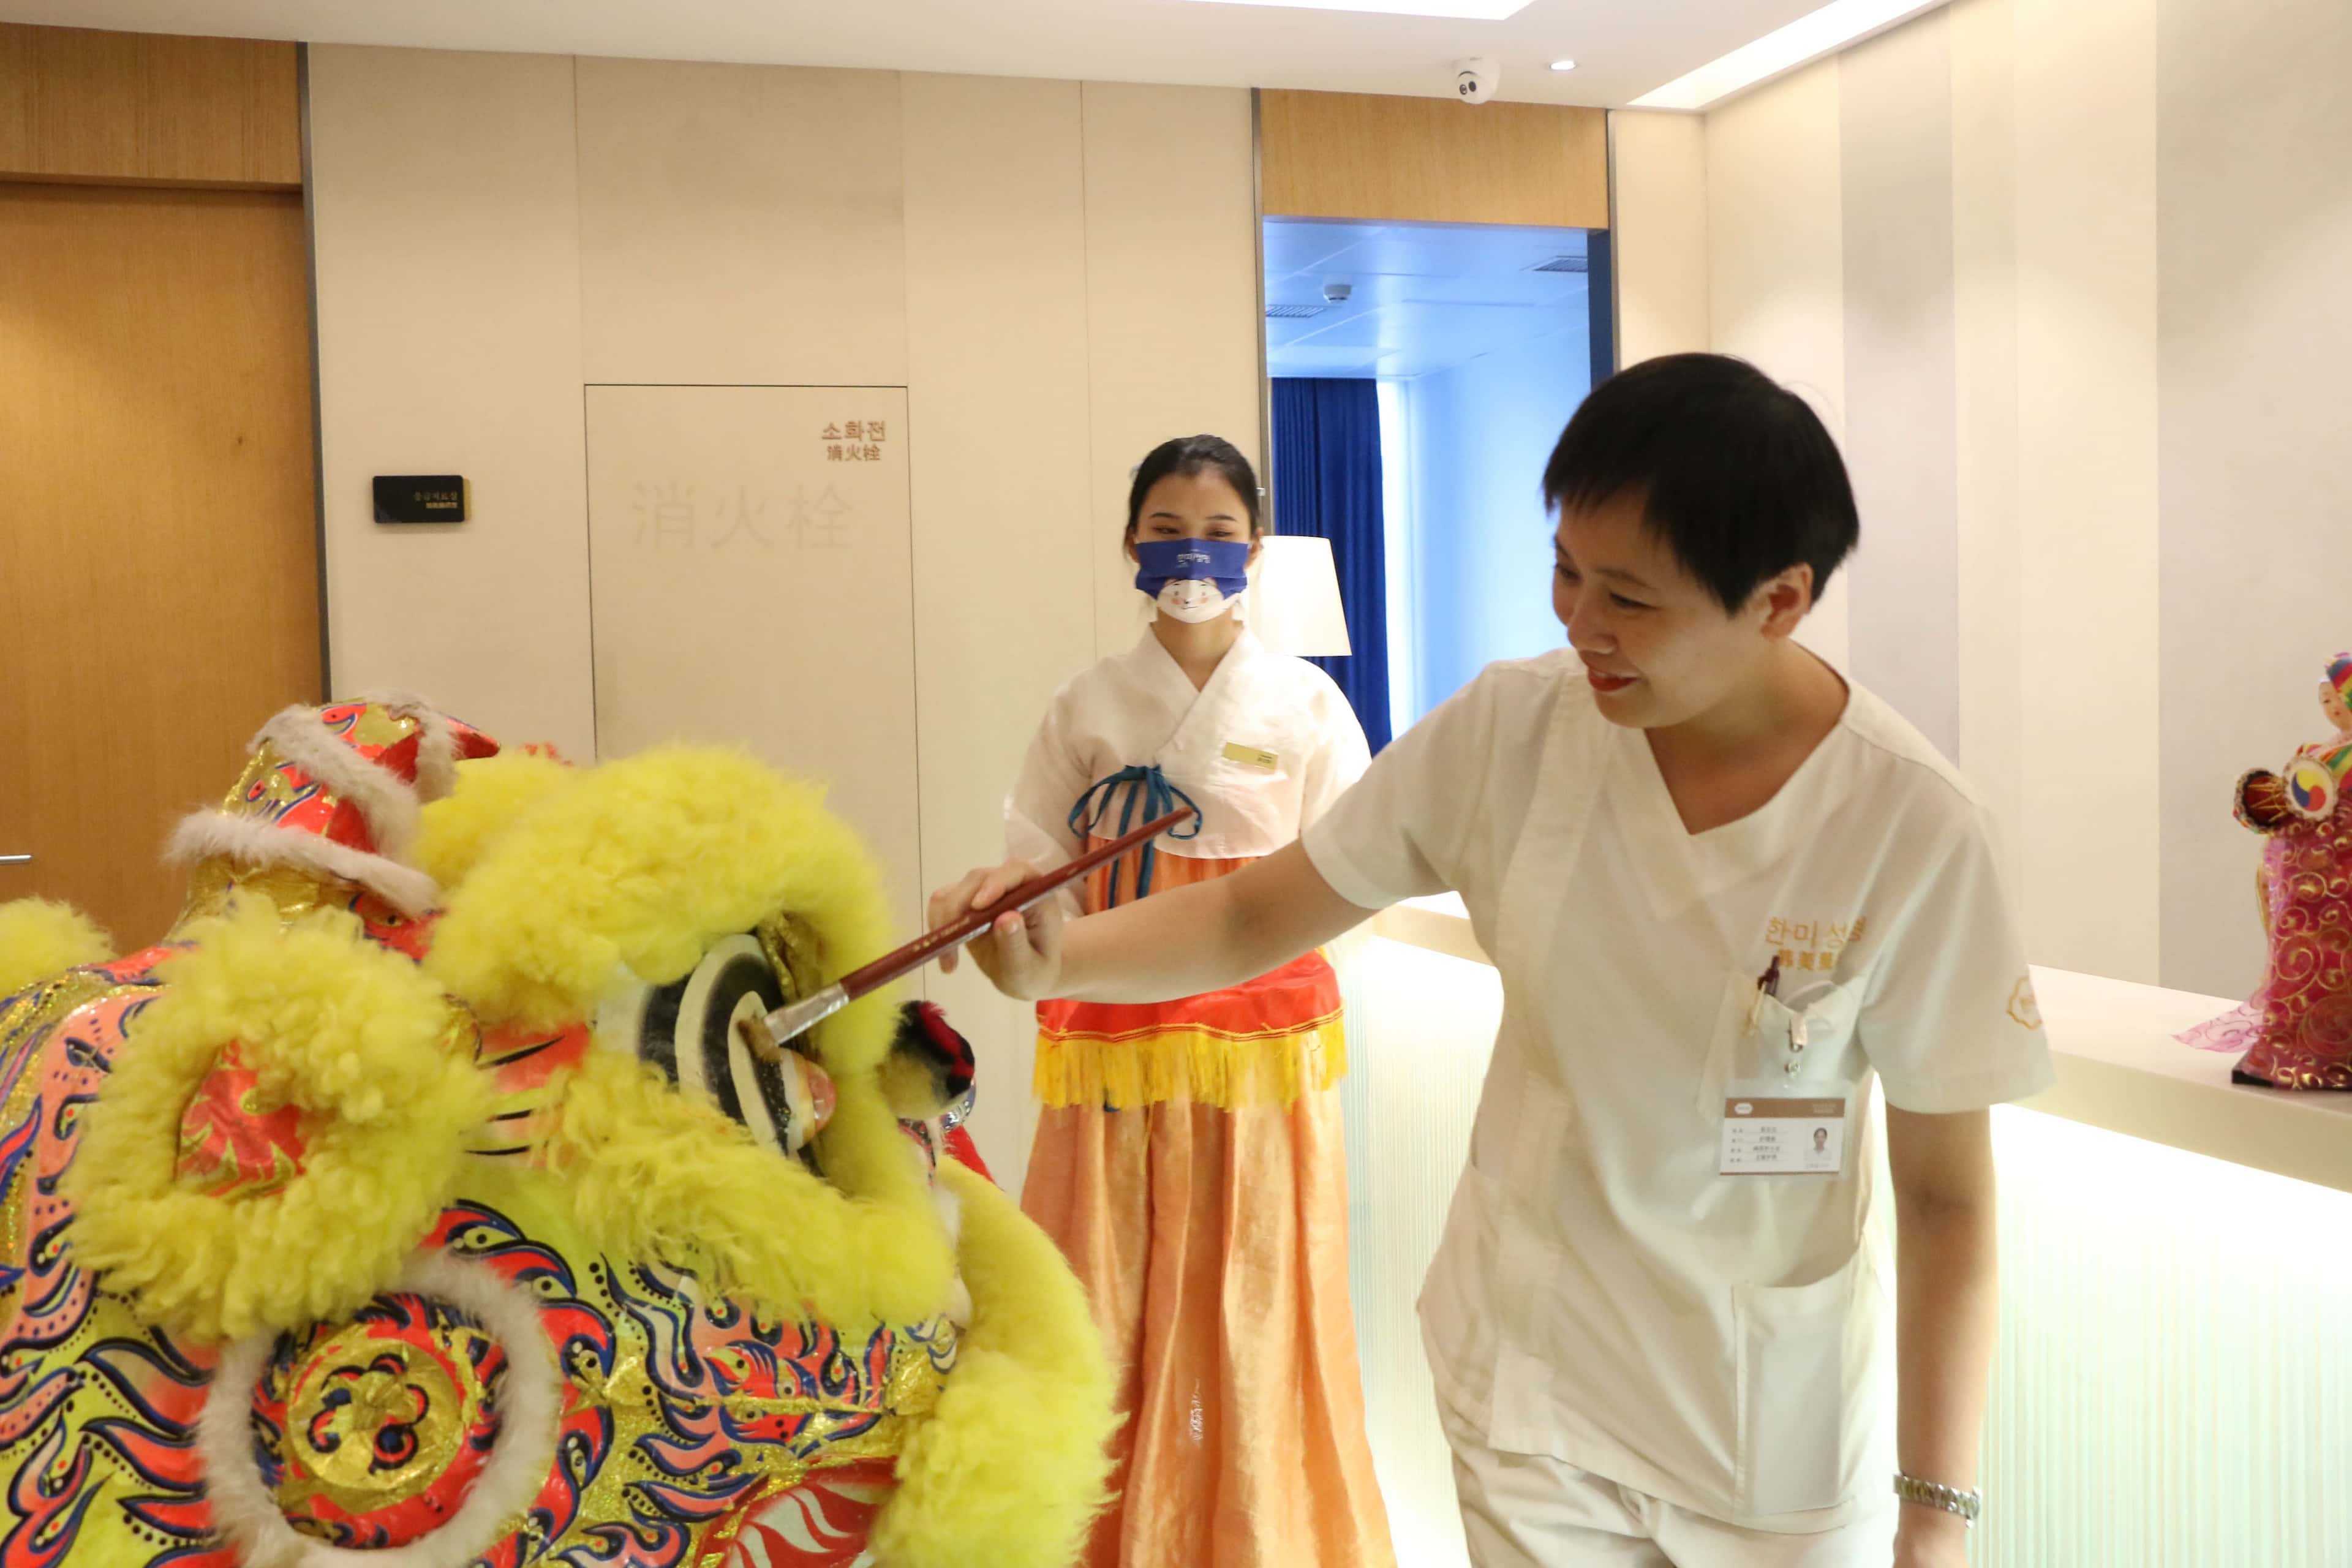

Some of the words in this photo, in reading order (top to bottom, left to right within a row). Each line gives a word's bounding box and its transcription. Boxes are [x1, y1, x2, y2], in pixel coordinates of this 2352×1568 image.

[821, 421, 885, 441] 소화전
[827, 444, 880, 461] 消火栓
[632, 480, 854, 549] 消火栓
